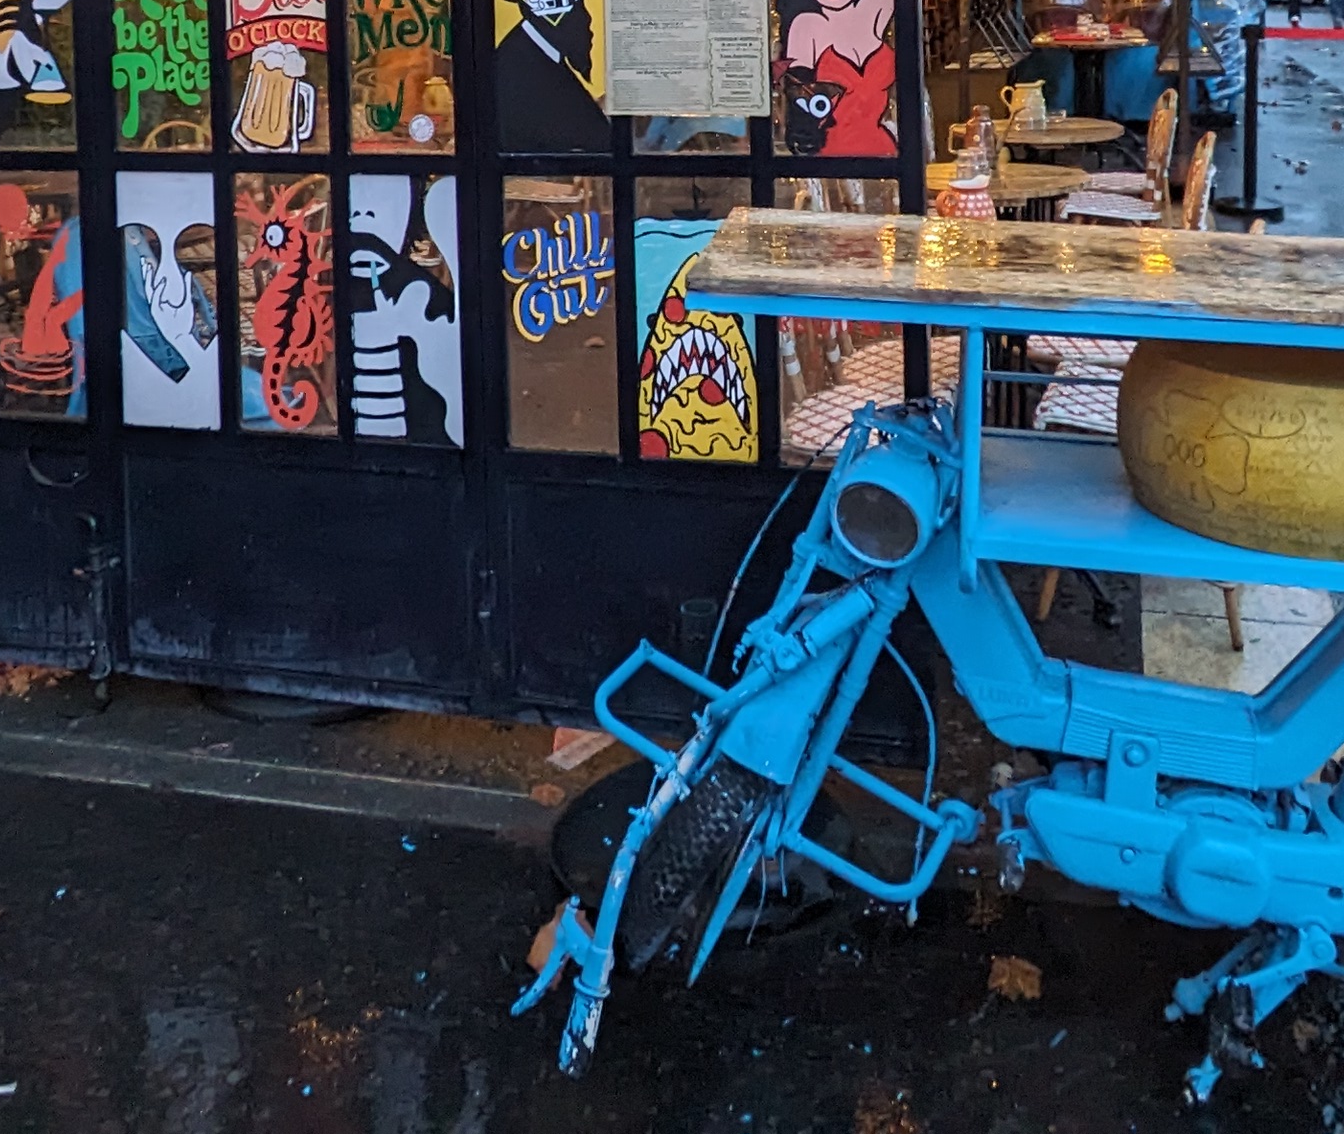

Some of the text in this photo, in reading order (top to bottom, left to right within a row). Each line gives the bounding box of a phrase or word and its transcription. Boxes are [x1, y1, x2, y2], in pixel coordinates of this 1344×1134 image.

[112, 4, 211, 64] be the
[227, 19, 326, 53] O'CLOCK
[112, 45, 212, 139] Place
[501, 210, 615, 284] Chill
[513, 265, 616, 343] Out
